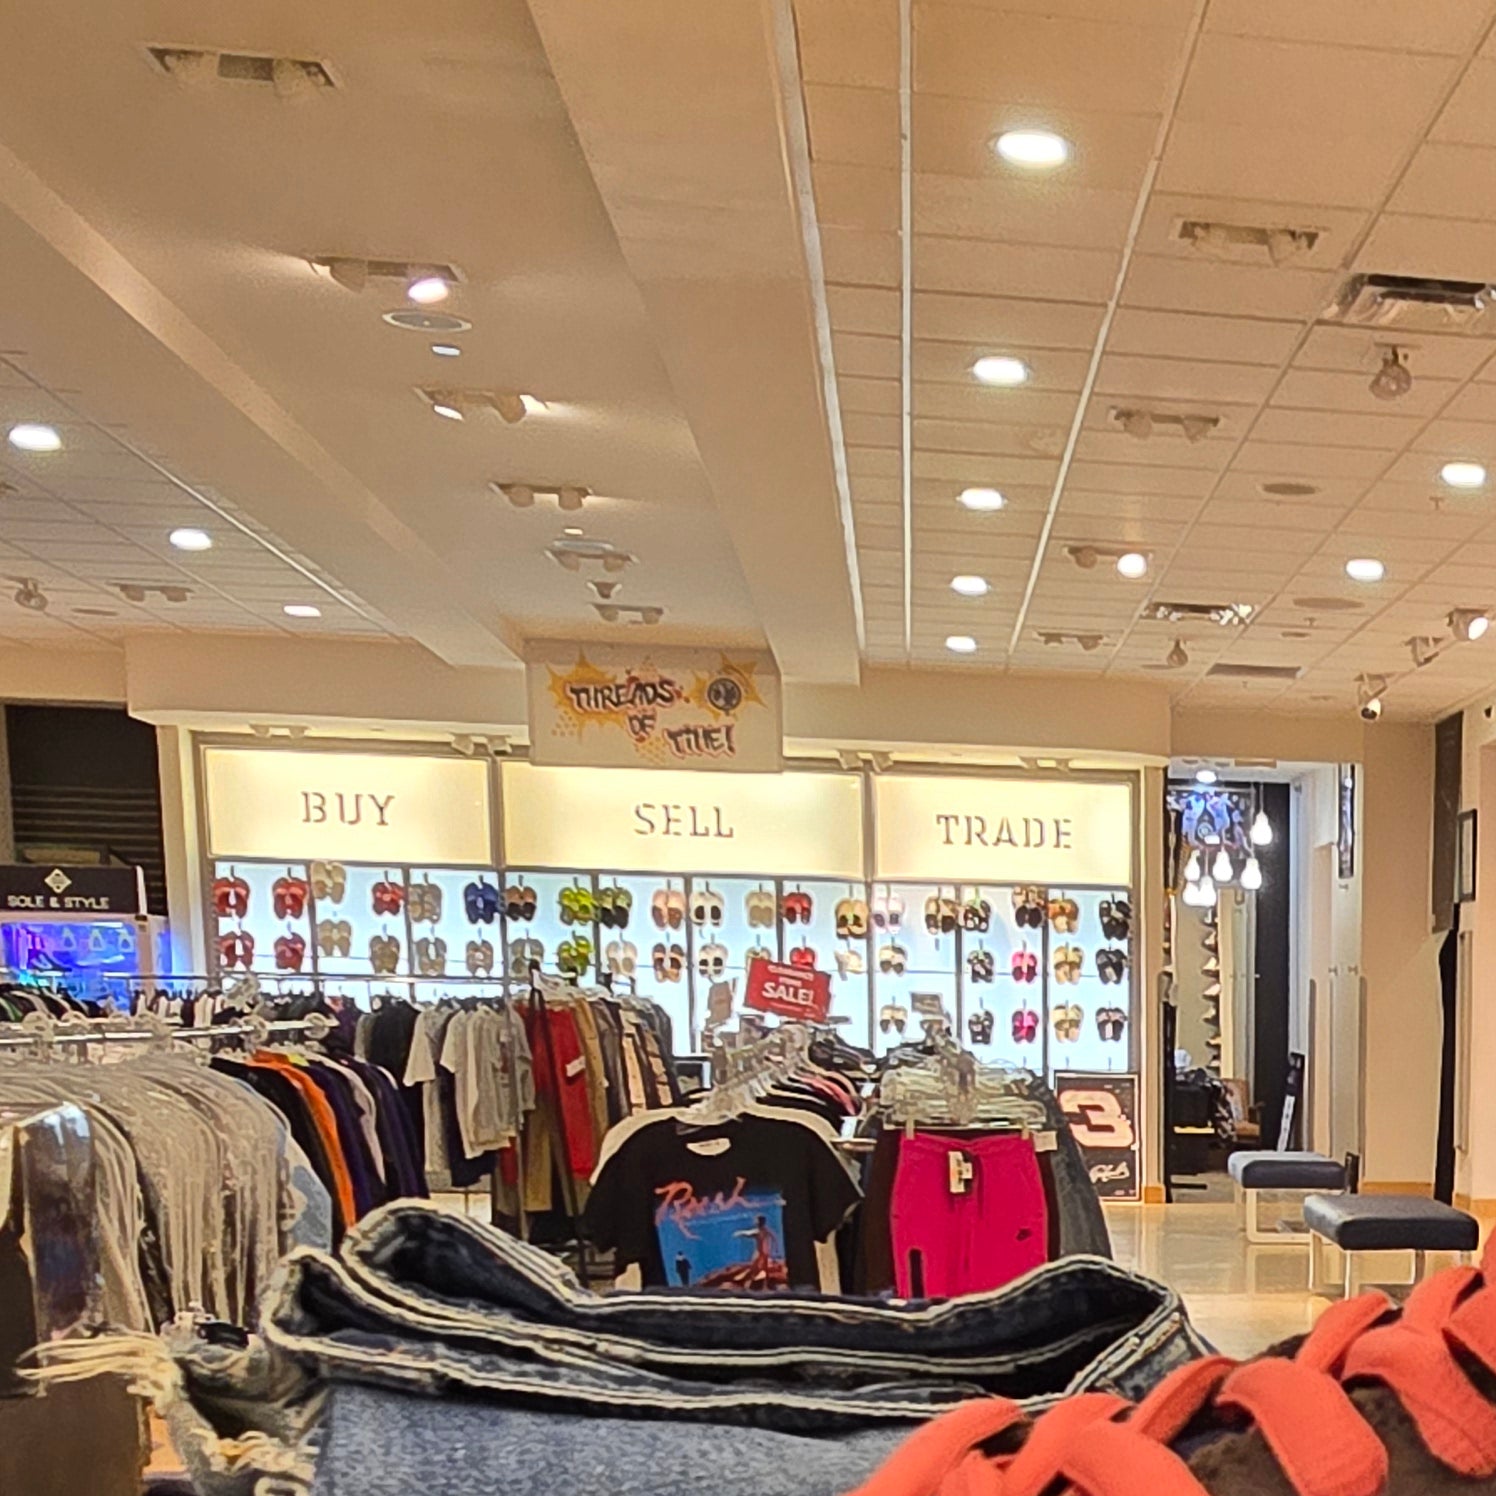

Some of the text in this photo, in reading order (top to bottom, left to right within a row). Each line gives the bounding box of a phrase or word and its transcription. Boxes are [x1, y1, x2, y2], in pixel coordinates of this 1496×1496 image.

[629, 712, 656, 736] OF
[300, 790, 396, 827] BUY
[633, 802, 735, 839] SELL
[935, 813, 1073, 850] TRADE
[7, 894, 45, 909] SOLE
[64, 896, 110, 910] STYLE
[1059, 1088, 1135, 1149] 3
